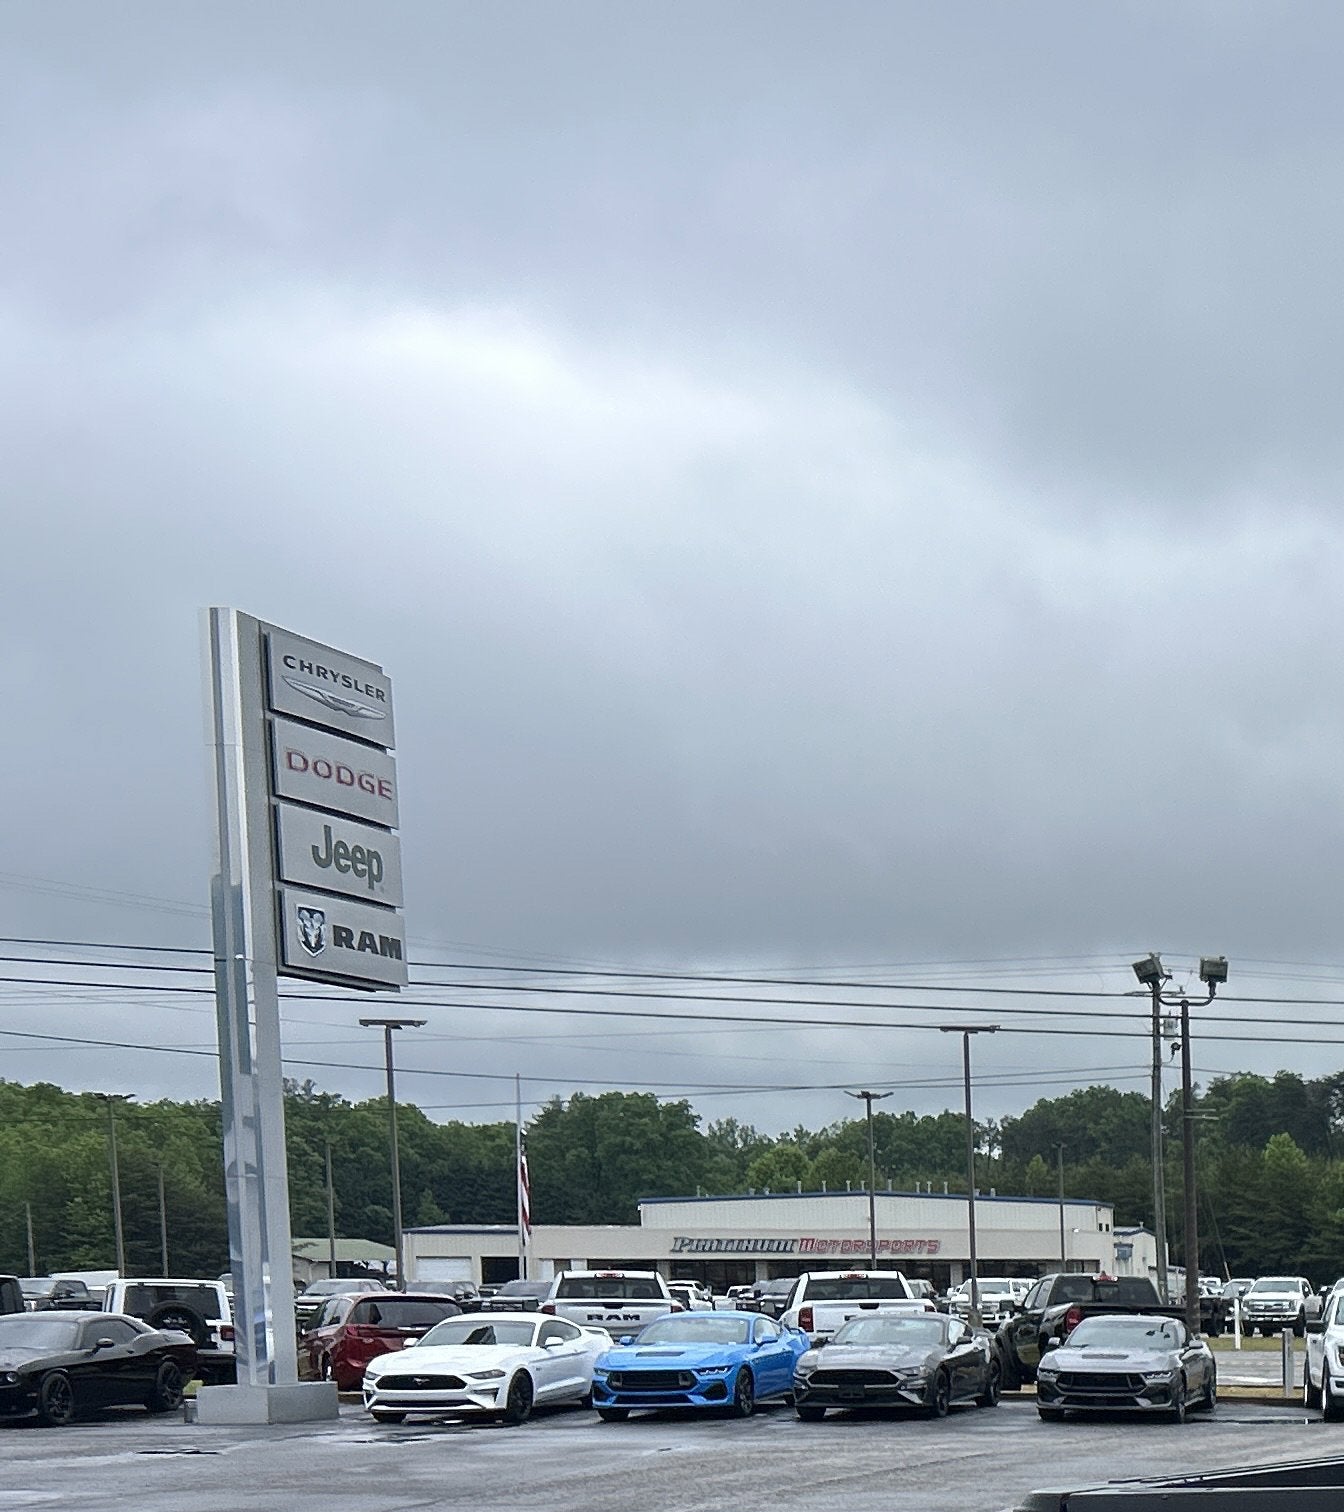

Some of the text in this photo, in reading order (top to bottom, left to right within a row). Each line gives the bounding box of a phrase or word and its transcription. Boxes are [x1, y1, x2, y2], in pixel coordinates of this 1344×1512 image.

[283, 654, 387, 703] CHRYSLER
[286, 750, 393, 800] DODGE
[311, 824, 384, 890] Jeep
[332, 924, 402, 961] RAM
[586, 1313, 641, 1321] RAM
